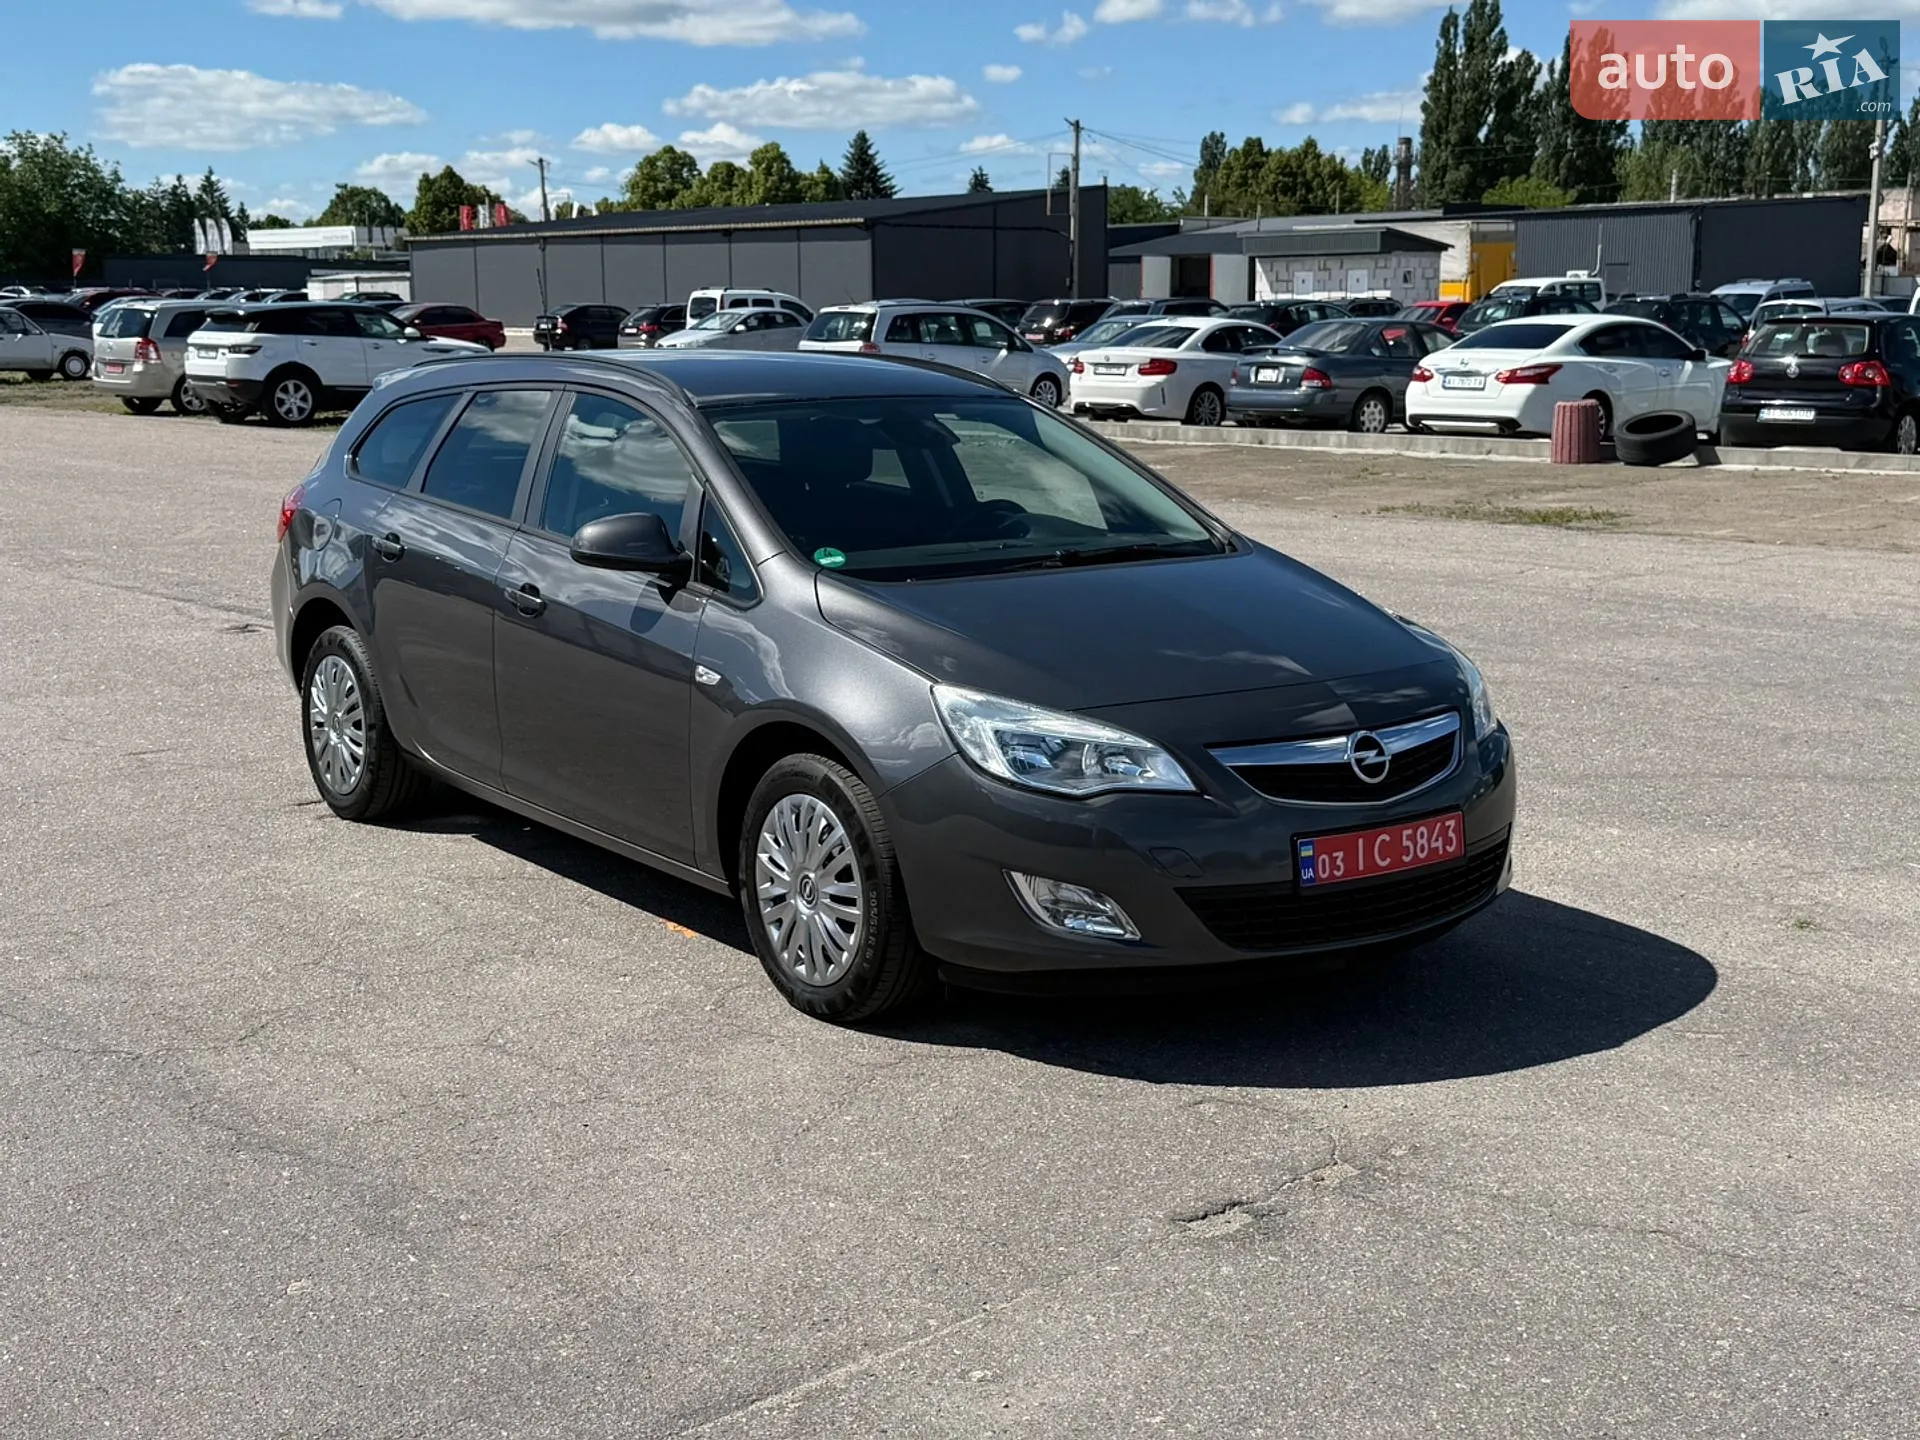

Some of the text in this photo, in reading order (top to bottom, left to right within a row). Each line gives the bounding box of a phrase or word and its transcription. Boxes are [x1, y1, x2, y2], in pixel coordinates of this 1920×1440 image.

[1318, 819, 1456, 879] 03 IC 5843
[1301, 869, 1315, 880] UA
